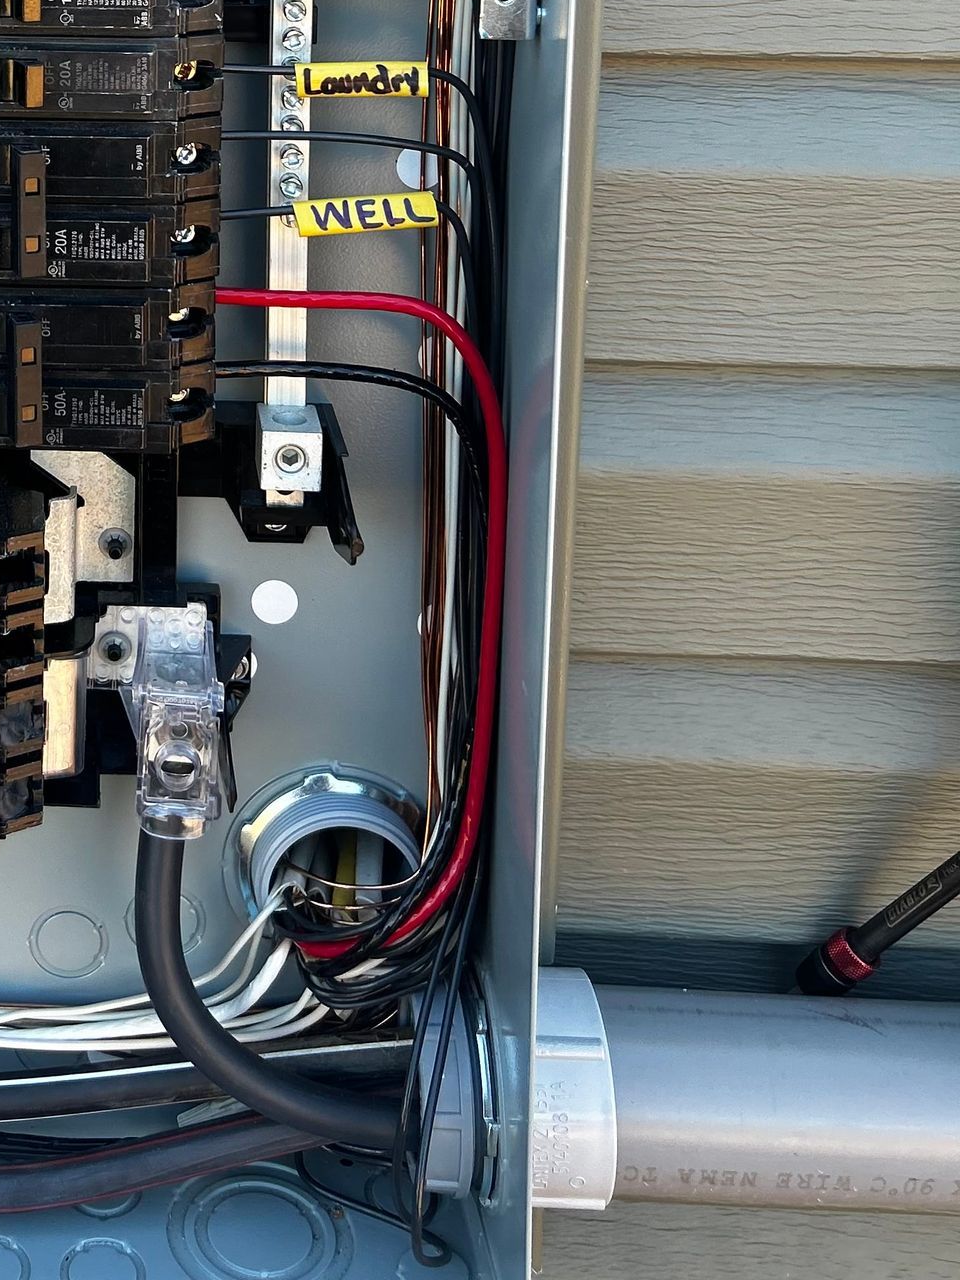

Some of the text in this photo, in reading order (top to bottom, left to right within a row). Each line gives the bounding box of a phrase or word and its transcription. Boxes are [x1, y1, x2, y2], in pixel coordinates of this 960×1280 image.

[60, 60, 71, 86] 20A
[303, 64, 419, 95] Laundry
[136, 160, 143, 170] by
[310, 198, 436, 231] WELL
[55, 230, 67, 254] 20A
[42, 317, 51, 337] OFF
[135, 329, 142, 339] by
[623, 1166, 657, 1183] TC
[677, 1168, 758, 1189] NEMA
[776, 1173, 851, 1192] WIRE
